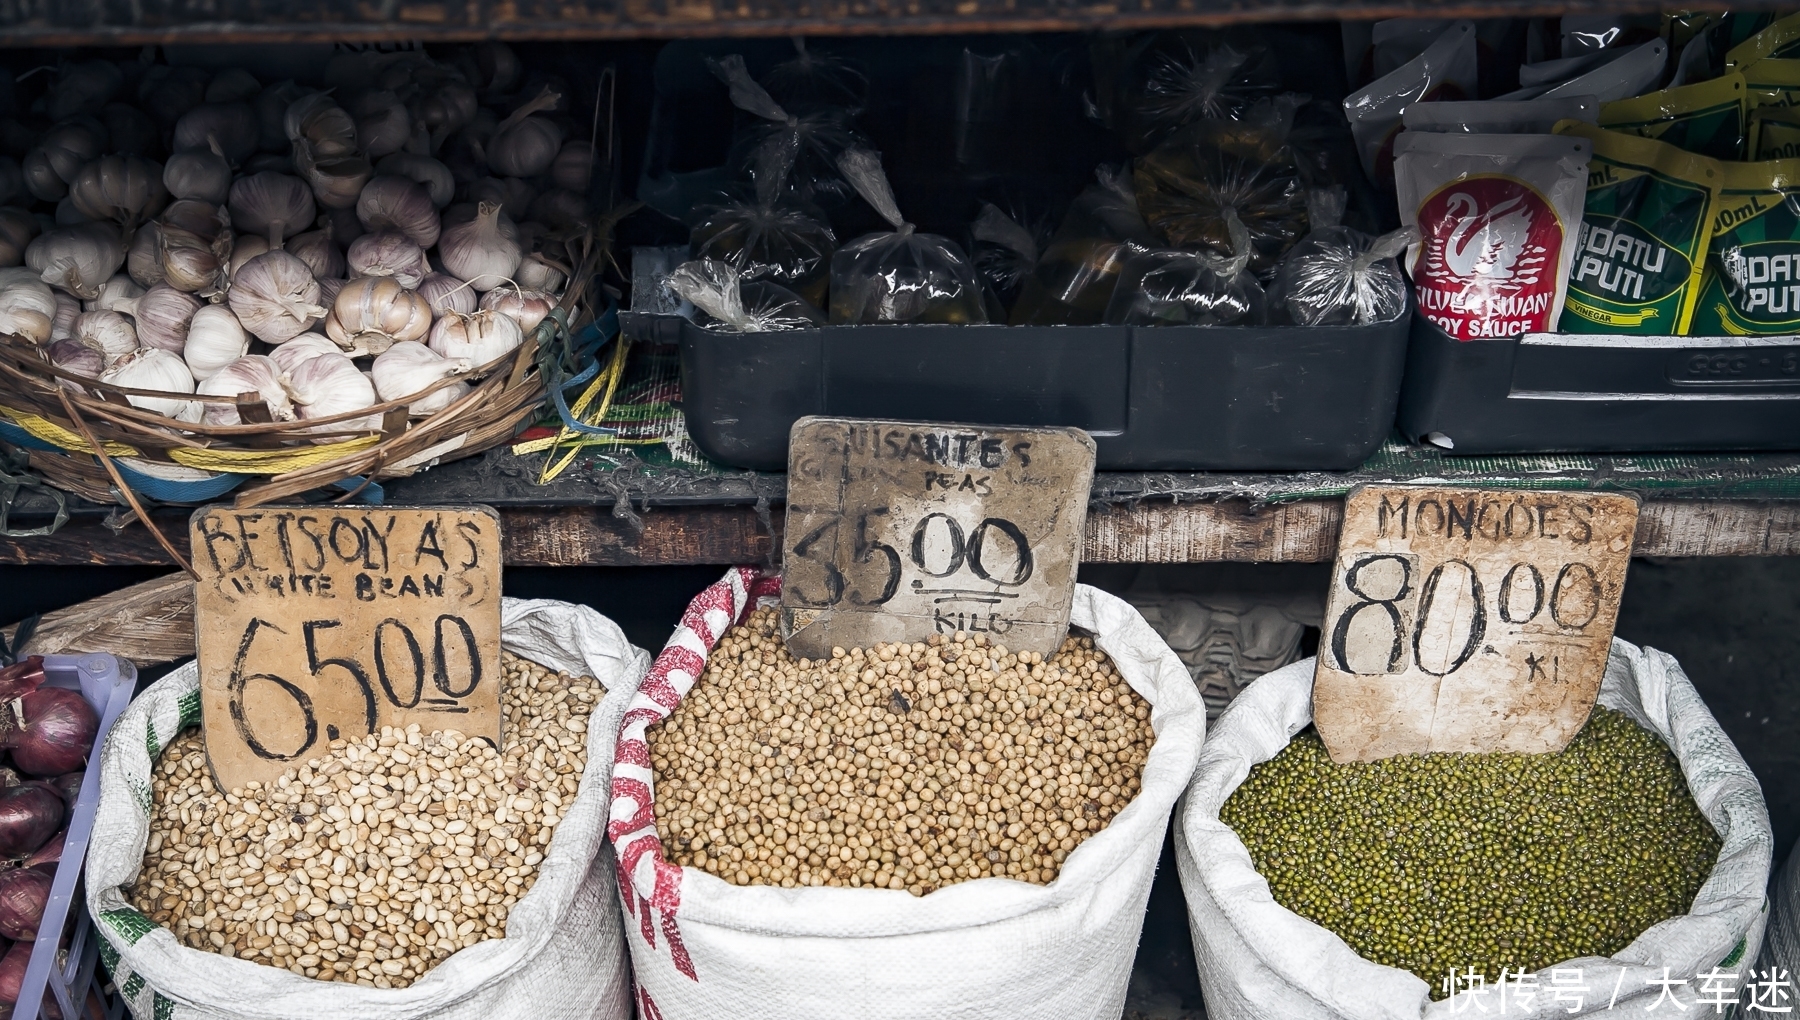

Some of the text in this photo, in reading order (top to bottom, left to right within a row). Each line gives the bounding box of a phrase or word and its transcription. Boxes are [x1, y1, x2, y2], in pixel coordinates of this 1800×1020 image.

[1586, 226, 1666, 272] DATU
[1576, 255, 1644, 299] PUTI
[1467, 319, 1532, 337] SAUCE
[1574, 303, 1612, 323] VINEGAR
[925, 471, 993, 497] PEAS
[1332, 554, 1600, 676] 80.00
